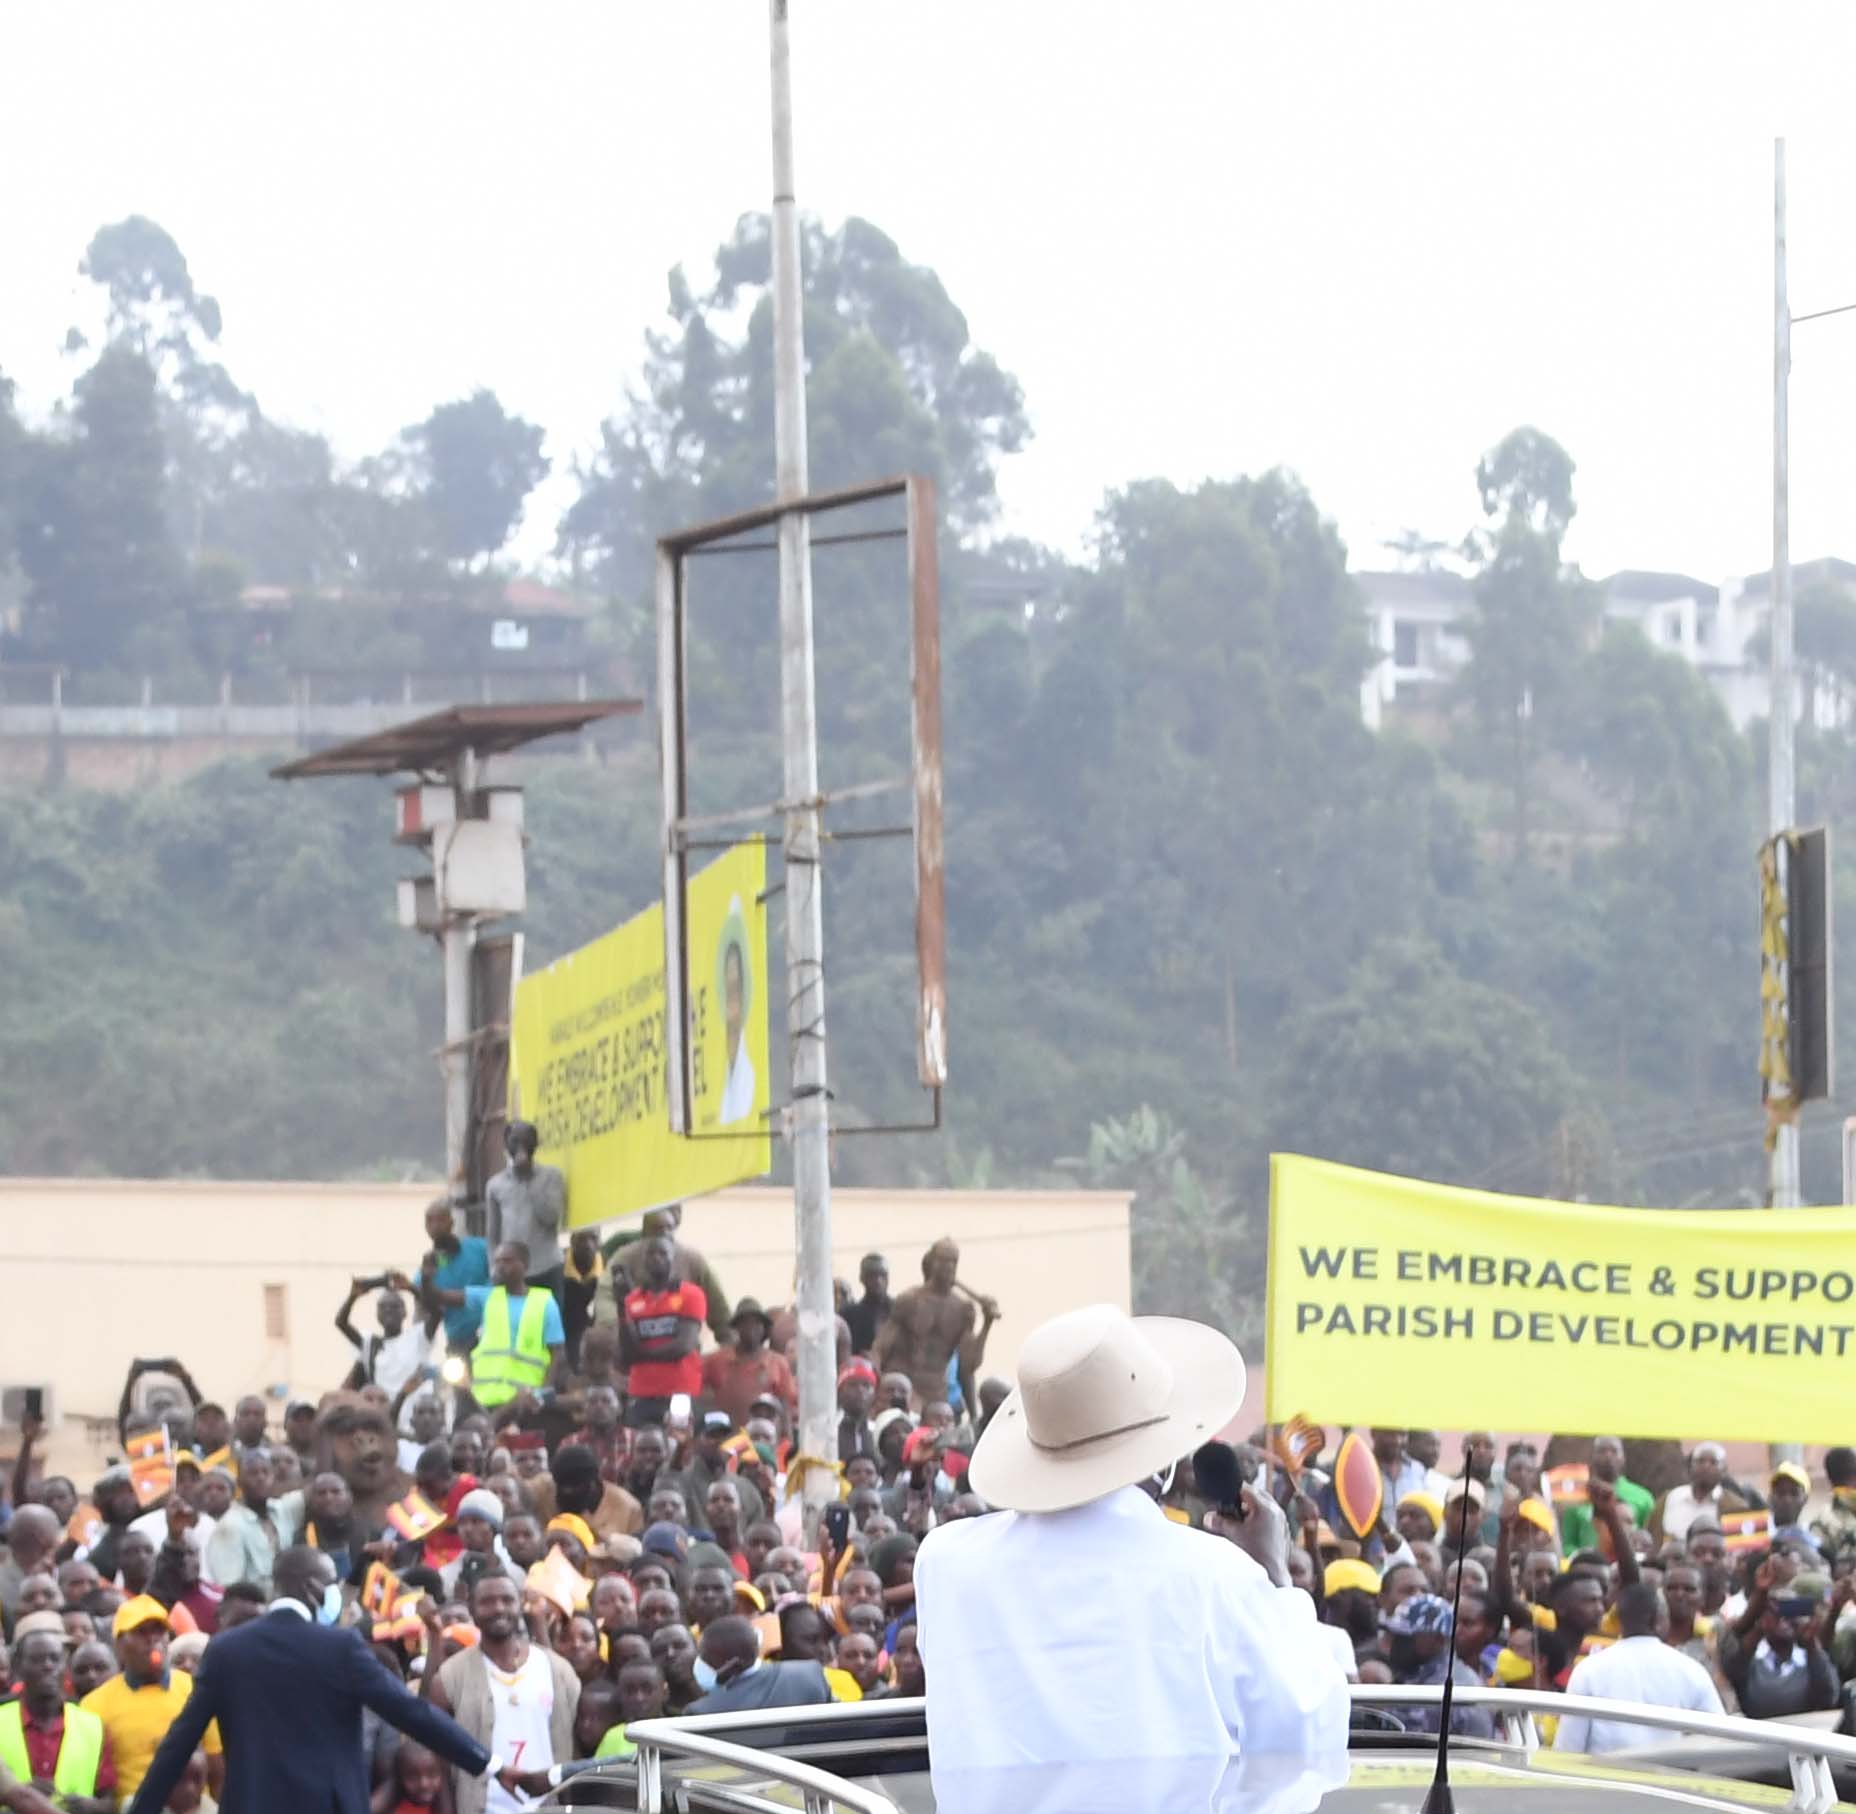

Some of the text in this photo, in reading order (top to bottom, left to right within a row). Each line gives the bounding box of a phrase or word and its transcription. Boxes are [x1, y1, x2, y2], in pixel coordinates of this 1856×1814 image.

[1299, 1247, 1378, 1280] WE
[1397, 1251, 1632, 1295] EMBRACE
[1648, 1266, 1675, 1297] &
[1296, 1303, 1474, 1339] PARISH
[1492, 1310, 1855, 1357] DEVELOPMENT
[509, 1740, 528, 1768] 7
